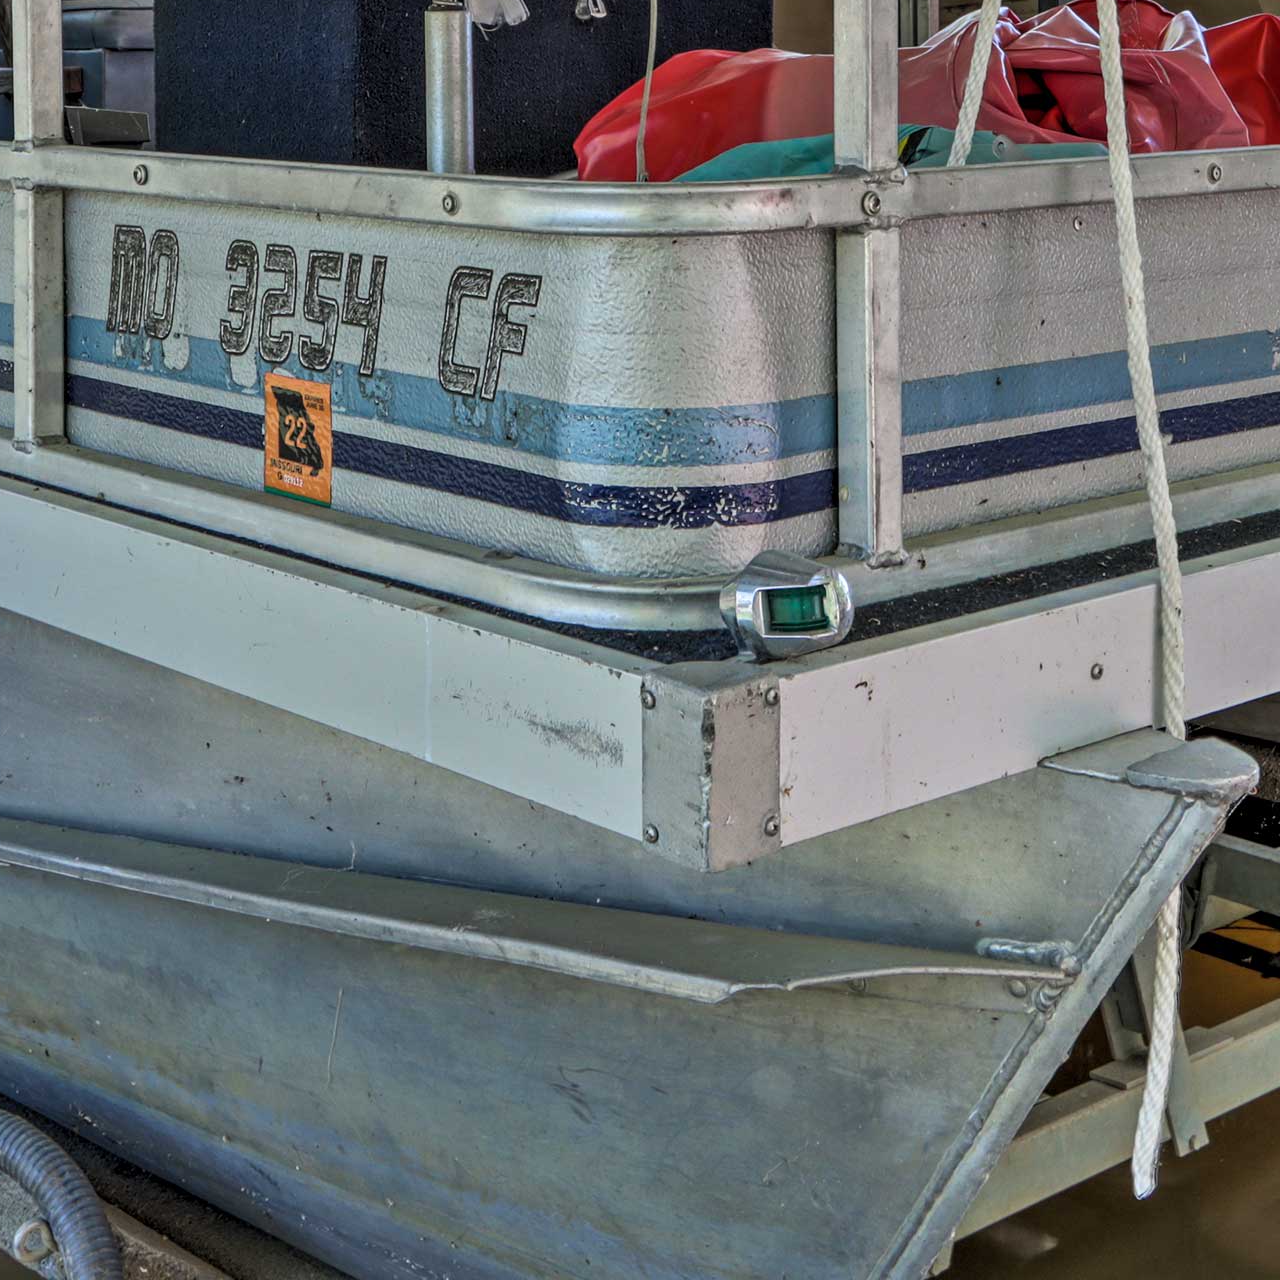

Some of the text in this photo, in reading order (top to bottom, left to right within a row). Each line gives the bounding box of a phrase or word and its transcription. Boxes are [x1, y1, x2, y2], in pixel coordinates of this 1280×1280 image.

[106, 224, 543, 401] MO 3254 CF
[285, 415, 307, 449] 22
[271, 458, 302, 474] MISSOURI
